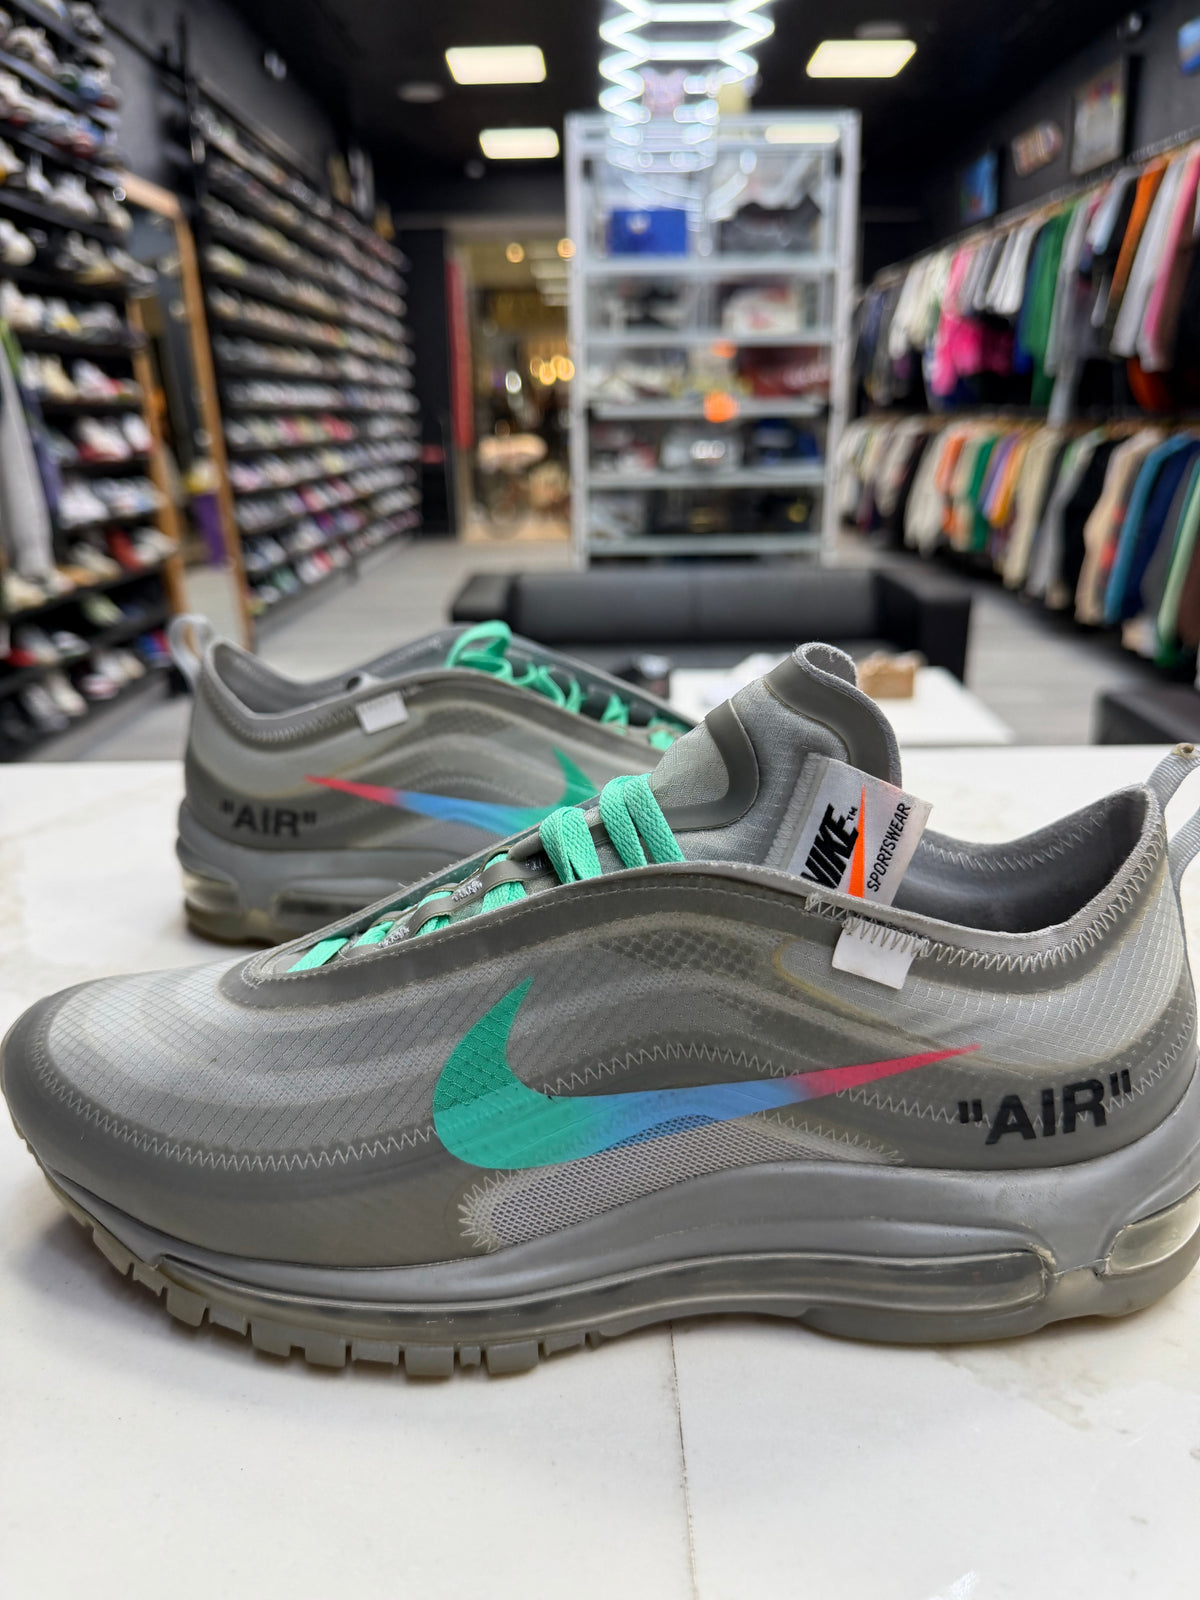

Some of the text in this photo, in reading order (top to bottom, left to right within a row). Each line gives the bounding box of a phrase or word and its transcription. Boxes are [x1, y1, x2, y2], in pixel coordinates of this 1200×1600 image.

[223, 799, 317, 838] "AIR"
[866, 802, 911, 892] SPORTSWEAR
[957, 1068, 1133, 1146] "AIR"
